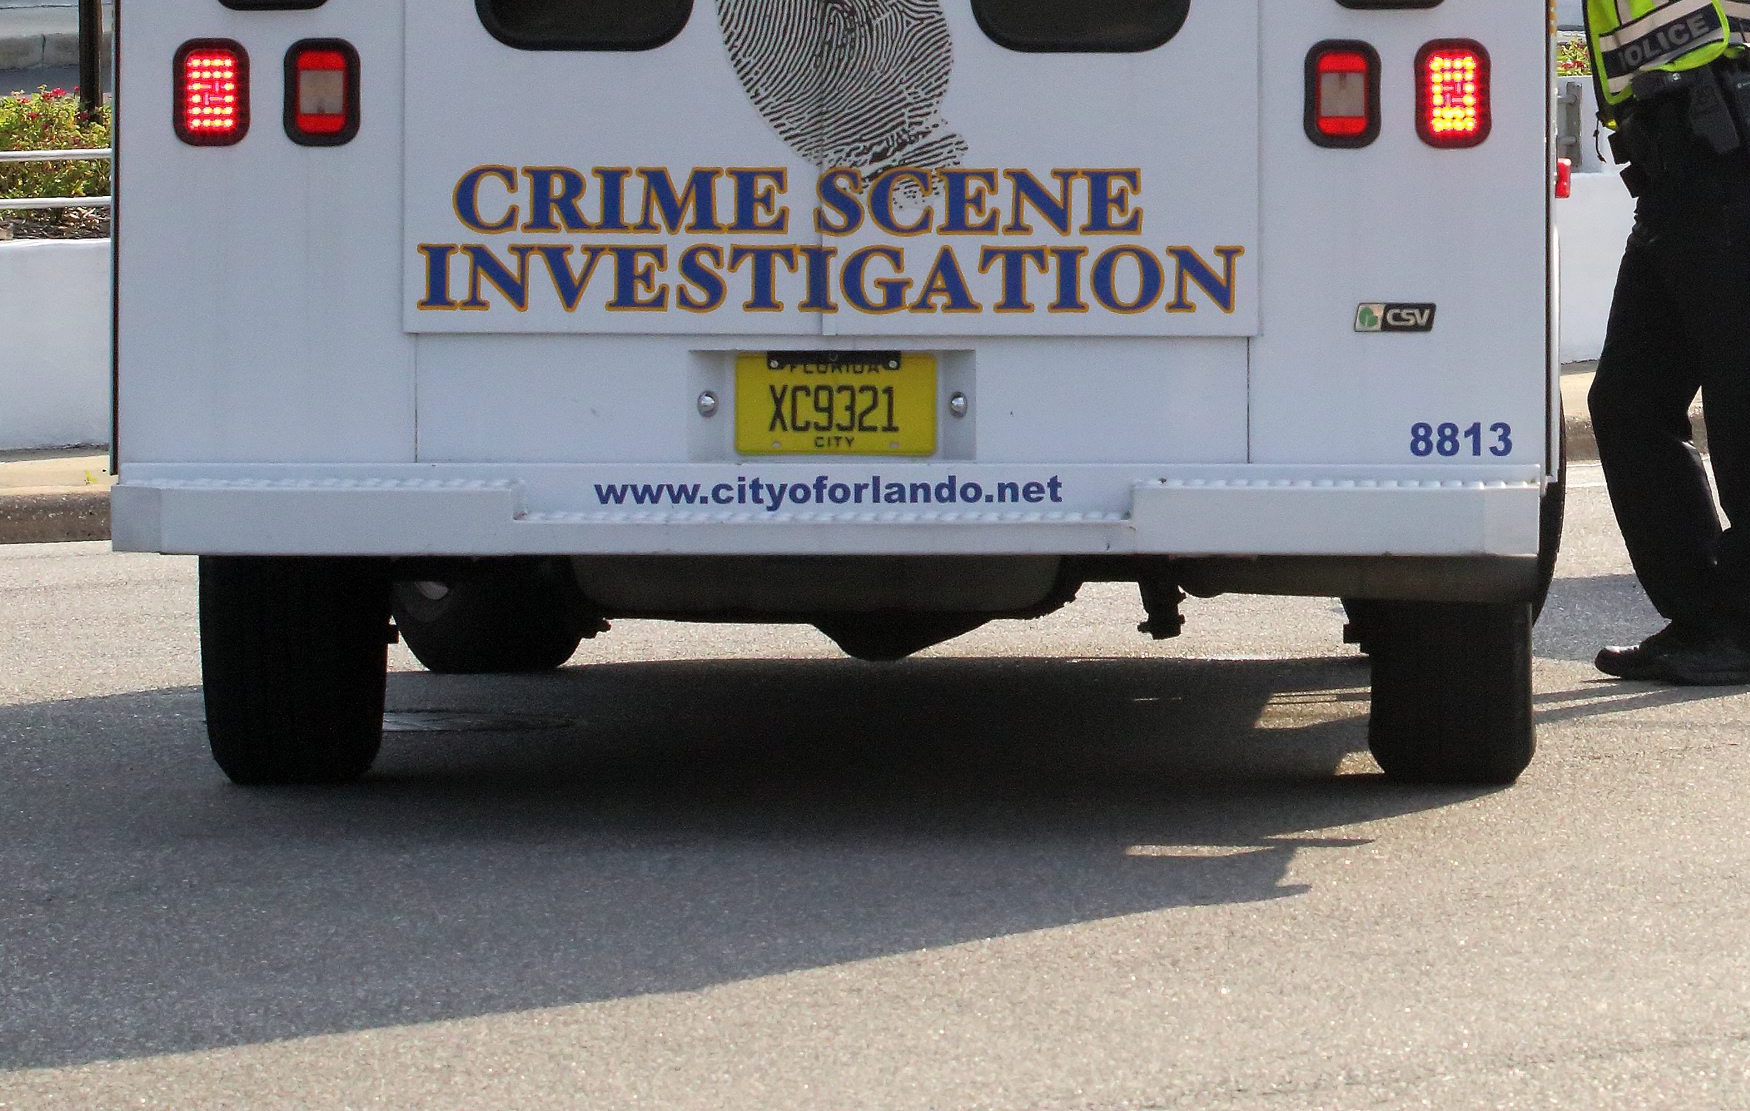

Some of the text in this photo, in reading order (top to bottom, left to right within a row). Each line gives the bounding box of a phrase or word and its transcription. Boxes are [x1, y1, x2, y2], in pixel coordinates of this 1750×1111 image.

[453, 164, 1143, 236] CRIME SCENE
[417, 242, 1244, 314] INVESTIGATION
[1387, 308, 1430, 327] CSV
[768, 384, 899, 432] XC9321
[814, 436, 856, 448] CITY
[1409, 422, 1513, 457] 8813
[593, 475, 1063, 507] www.cityoforlando.net
